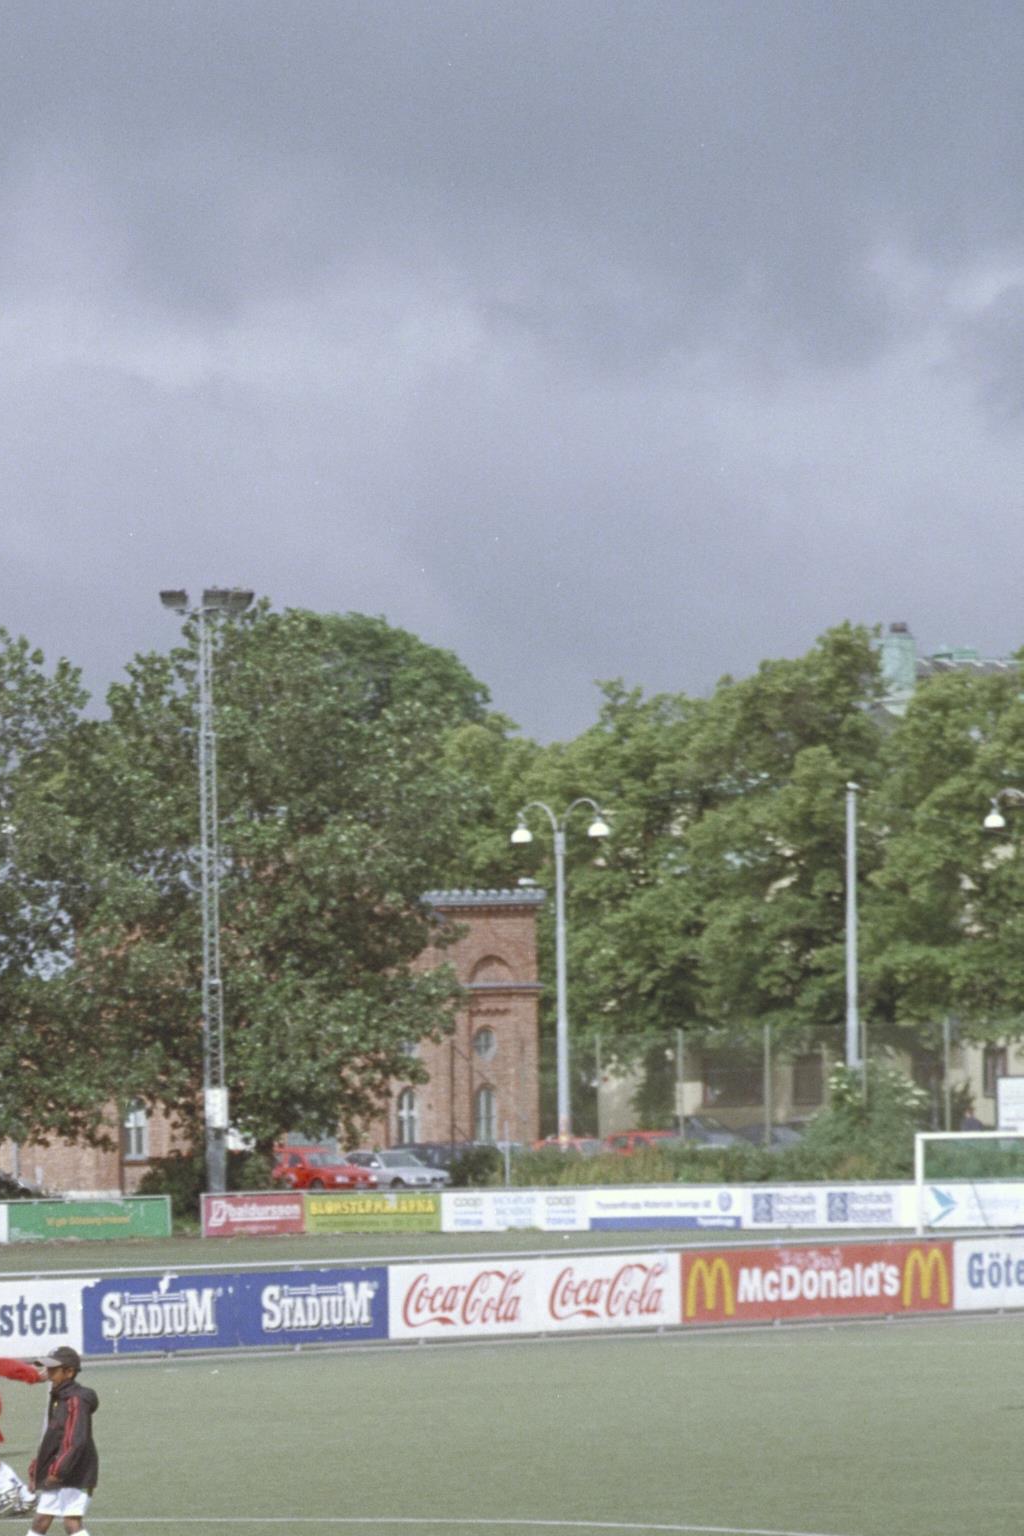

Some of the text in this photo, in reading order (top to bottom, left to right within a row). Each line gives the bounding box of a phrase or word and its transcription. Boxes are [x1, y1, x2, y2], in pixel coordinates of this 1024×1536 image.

[261, 1281, 373, 1333] STADIUM
[402, 1270, 524, 1328] Coca-Cola
[548, 1263, 667, 1322] Coca-Cola
[737, 1262, 900, 1303] McDonald's
[101, 1288, 218, 1341] STADIUM
